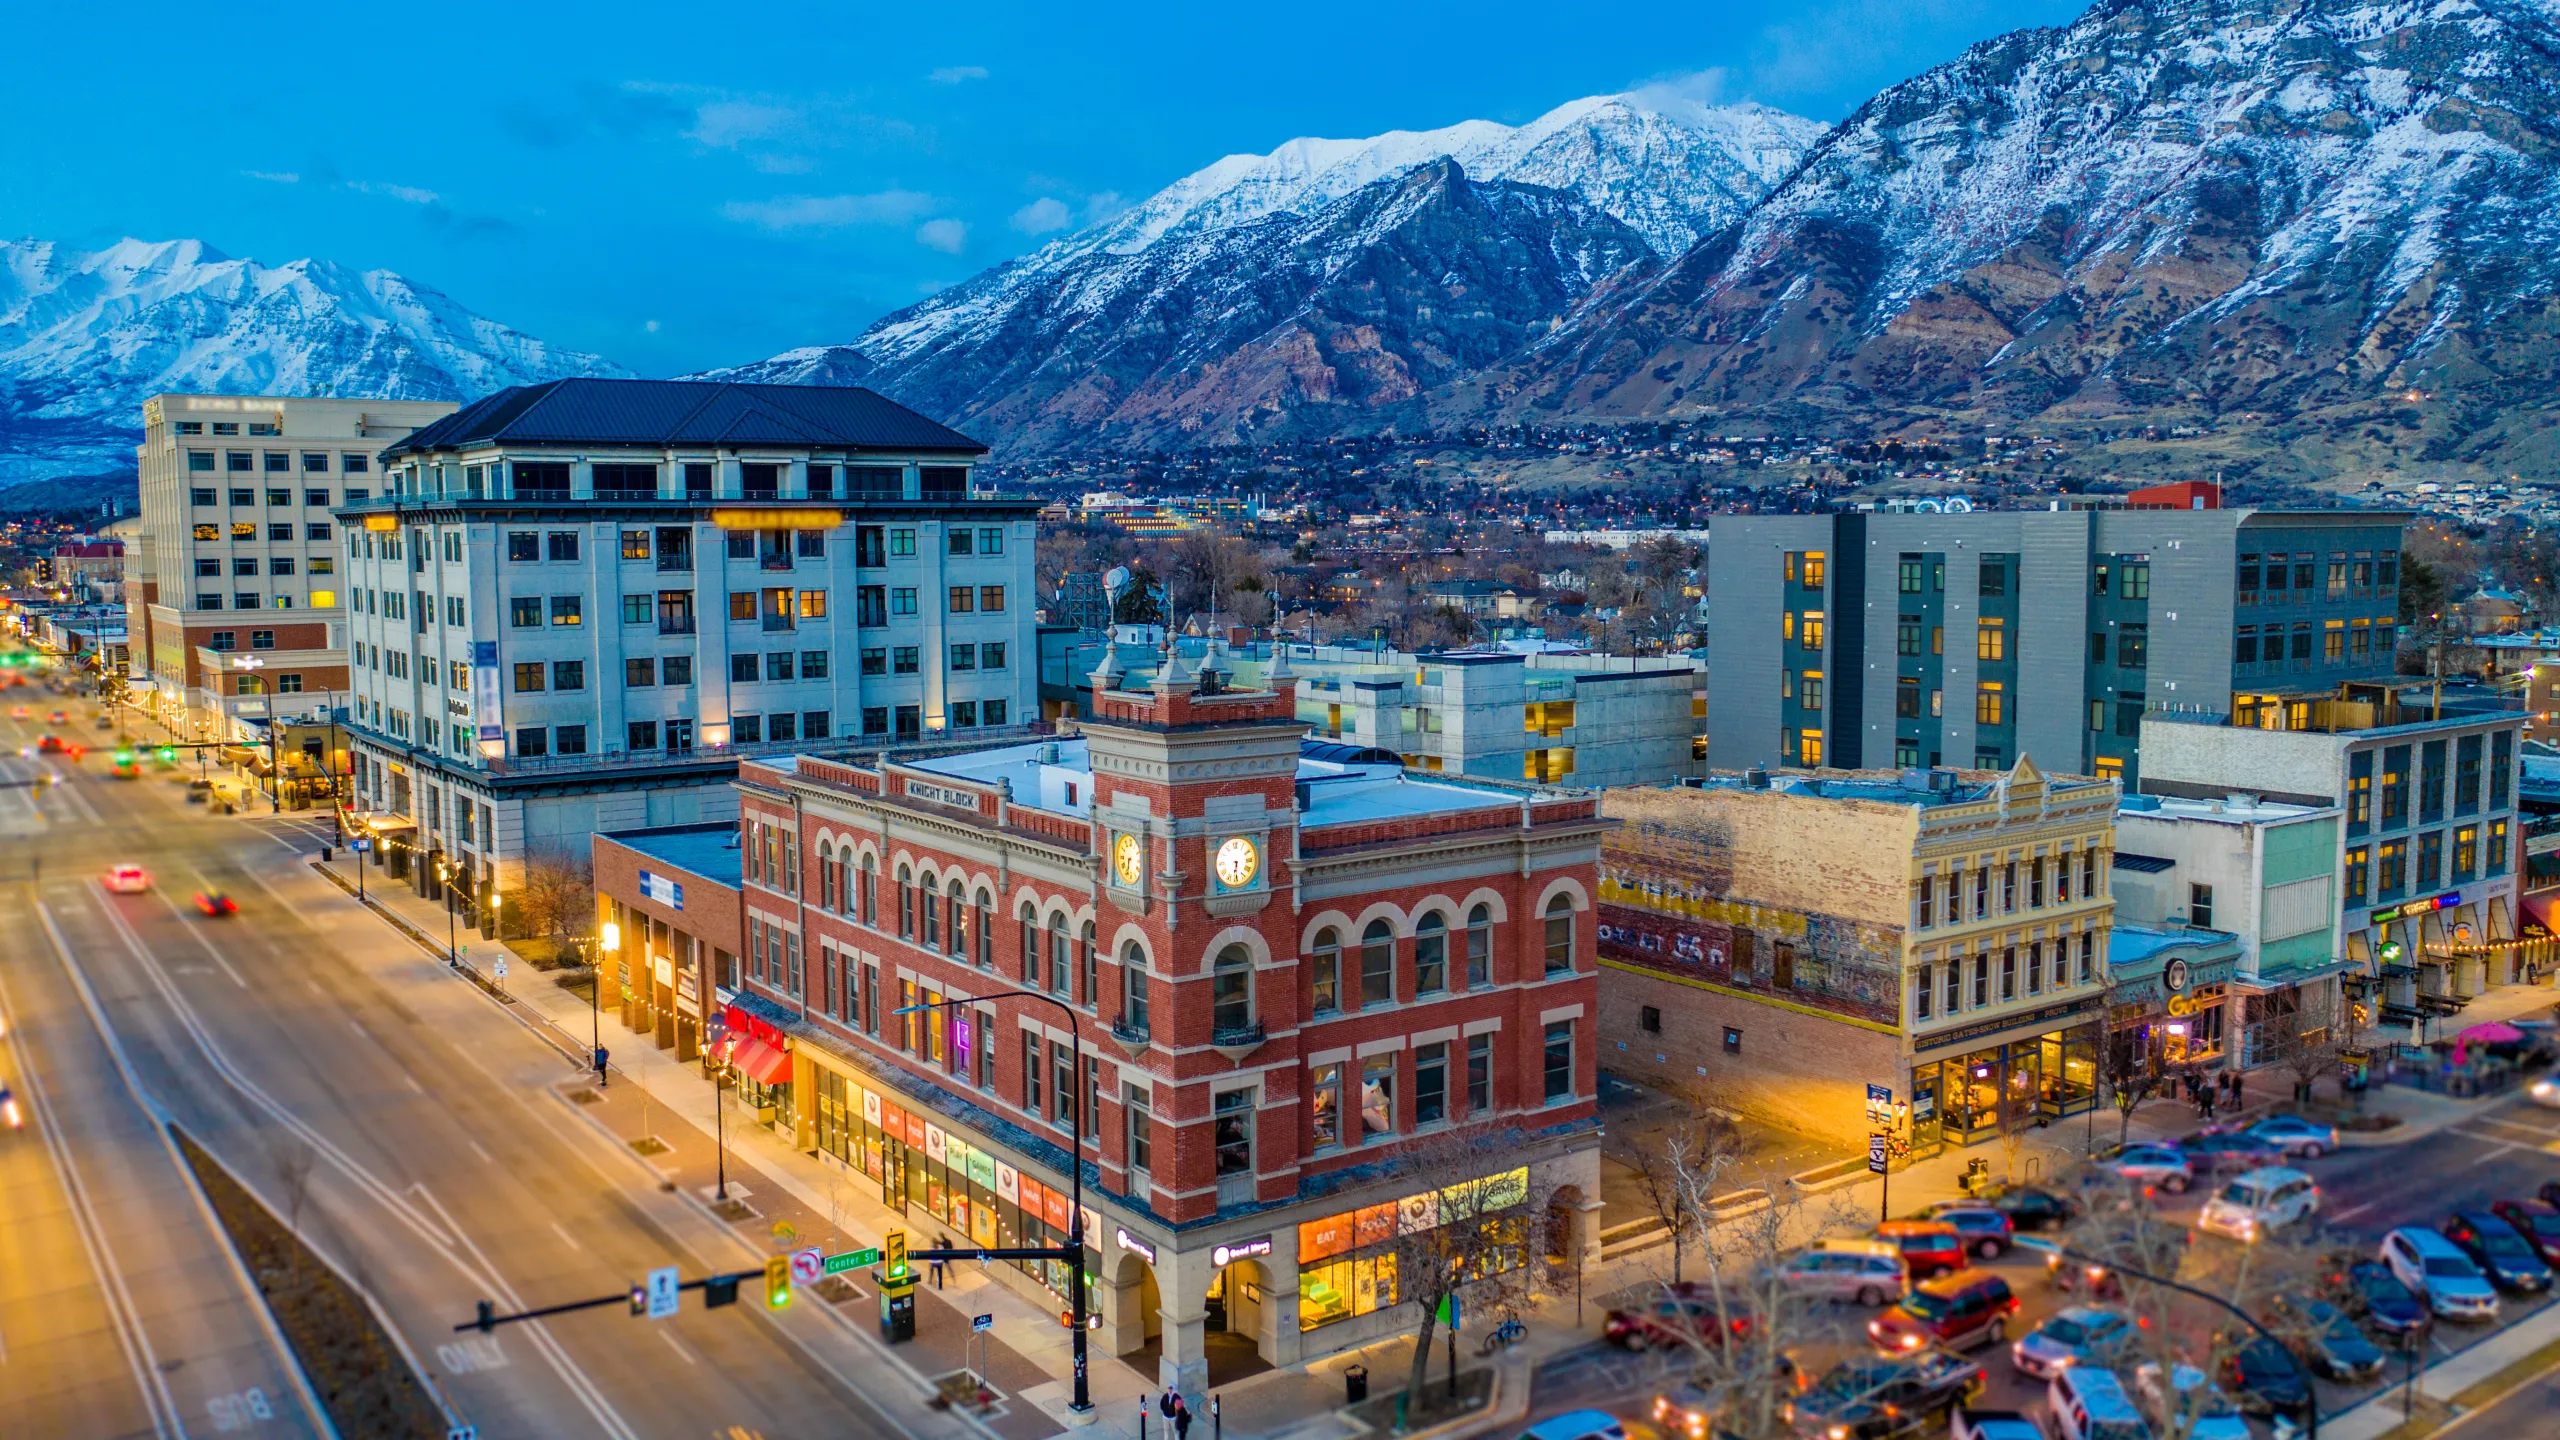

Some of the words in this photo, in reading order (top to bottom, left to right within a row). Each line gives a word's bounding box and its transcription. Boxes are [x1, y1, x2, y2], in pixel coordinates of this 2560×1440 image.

[910, 782, 940, 800] KNIGHT
[944, 789, 974, 808] BLOCK
[1915, 1032, 1951, 1048] HISTORIC
[1952, 1022, 2000, 1040] GATES-SNOW
[2002, 1013, 2035, 1027] BUILDING
[2044, 1005, 2068, 1018] PROVO
[2080, 998, 2099, 1009] UTAH
[907, 1123, 923, 1140] FOOD
[948, 1145, 963, 1161] PLAY
[972, 1158, 992, 1178] GAMES
[1022, 1188, 1041, 1205] HAVE
[1048, 1200, 1063, 1217] FUN
[1230, 1245, 1249, 1258] Good
[1250, 1241, 1270, 1252] Move
[1316, 1230, 1336, 1245] EAT
[829, 1255, 859, 1271] Center
[864, 1251, 875, 1262] St
[437, 1337, 509, 1374] ONLY
